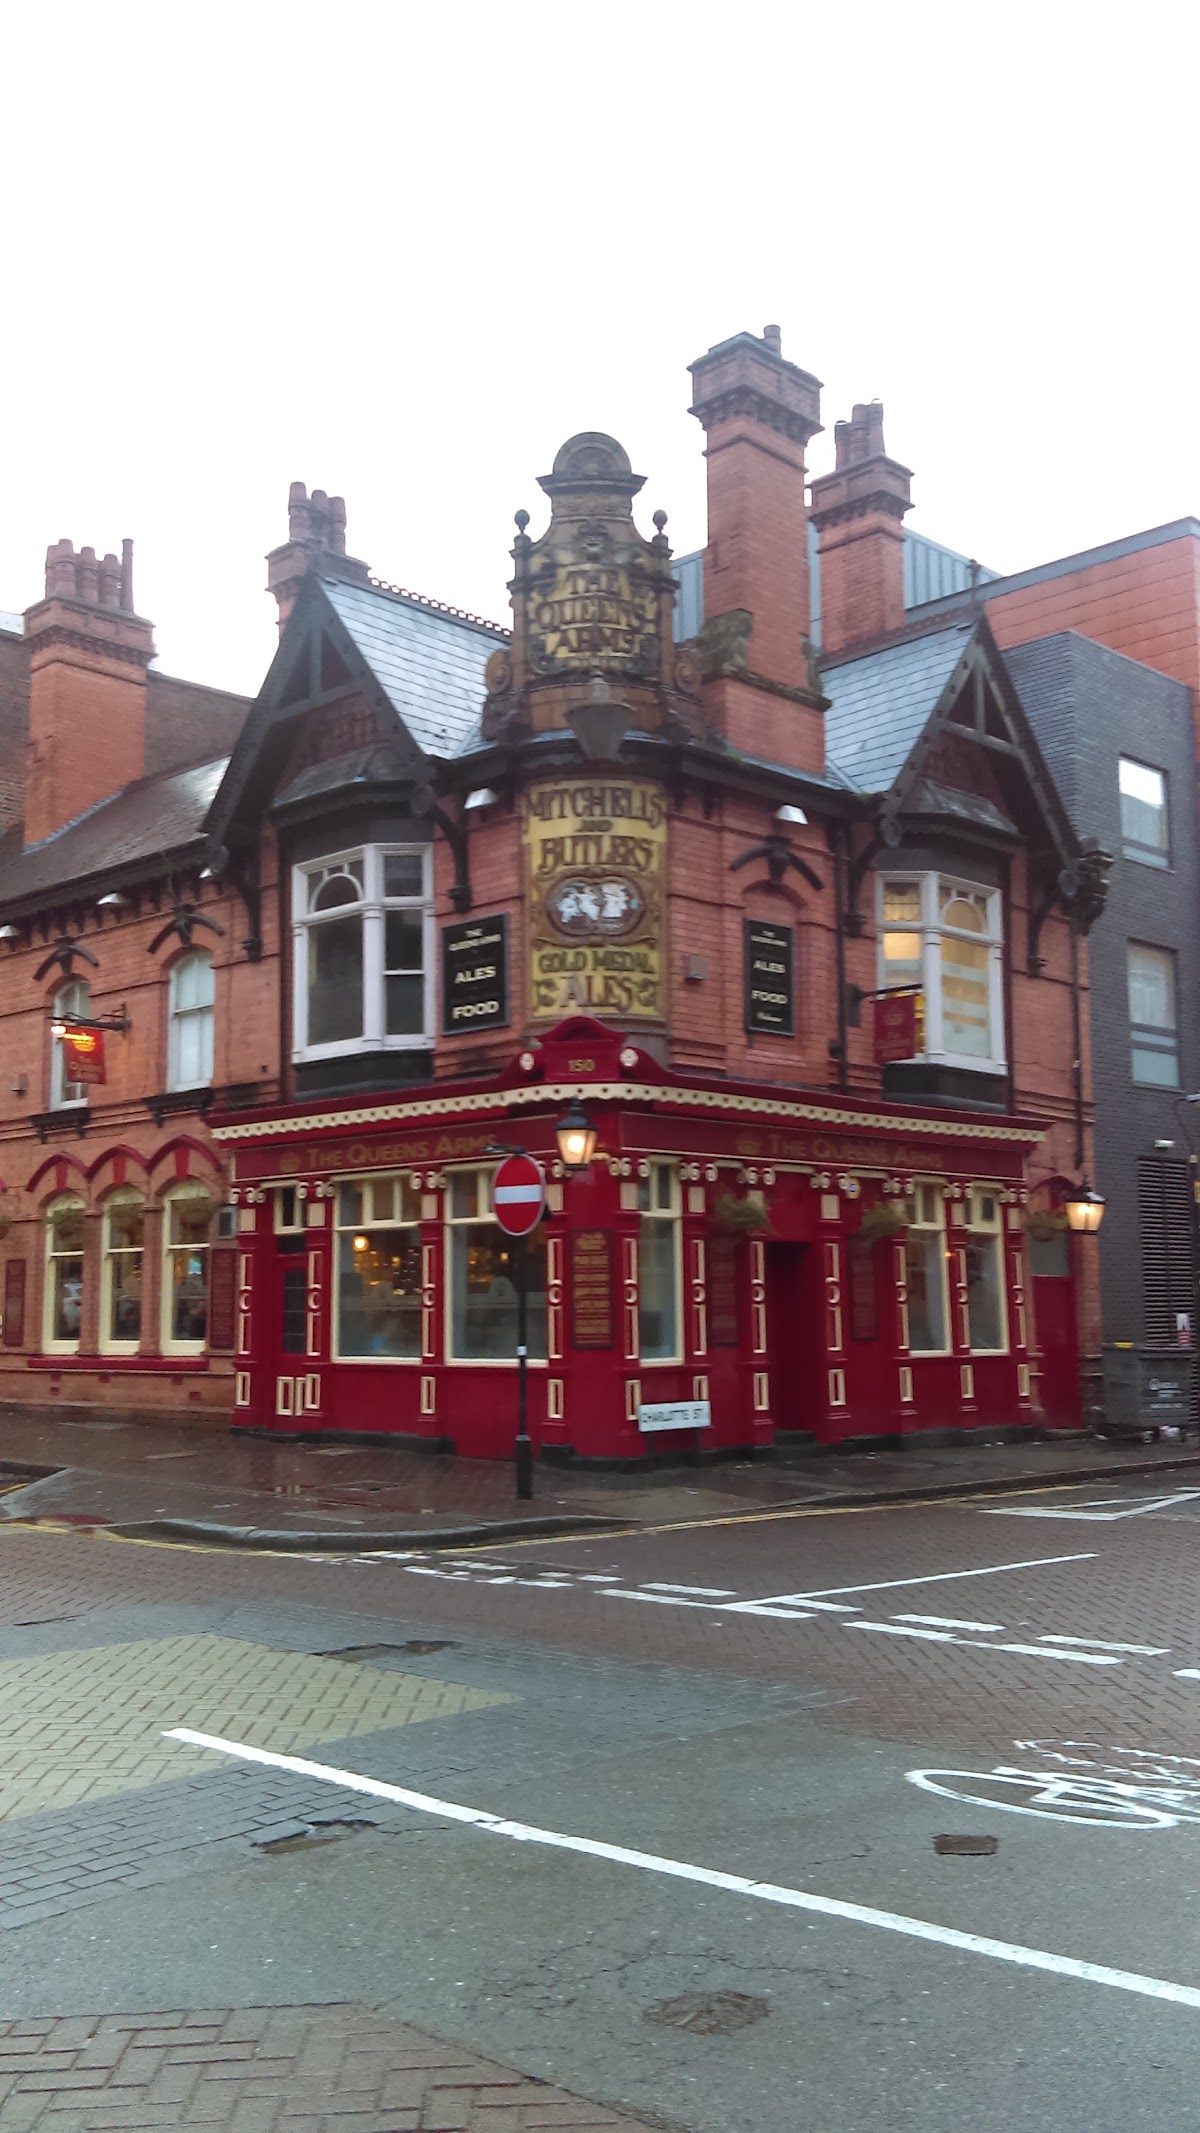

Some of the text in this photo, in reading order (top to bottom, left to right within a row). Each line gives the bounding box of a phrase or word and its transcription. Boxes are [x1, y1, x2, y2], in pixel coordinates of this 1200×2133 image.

[520, 786, 665, 833] MITCHELLS
[537, 834, 654, 876] BUTLERS
[538, 950, 656, 975] GOLD MEDAL
[752, 960, 786, 974] ALES
[455, 965, 497, 984] ALES
[559, 975, 633, 1014] ALES
[751, 989, 788, 1005] FOOD
[452, 1000, 500, 1020] FOOD
[308, 1134, 497, 1168] THE QUEENS ARMS
[768, 1134, 806, 1157] THE
[641, 1408, 689, 1424] CHARLOTTE
